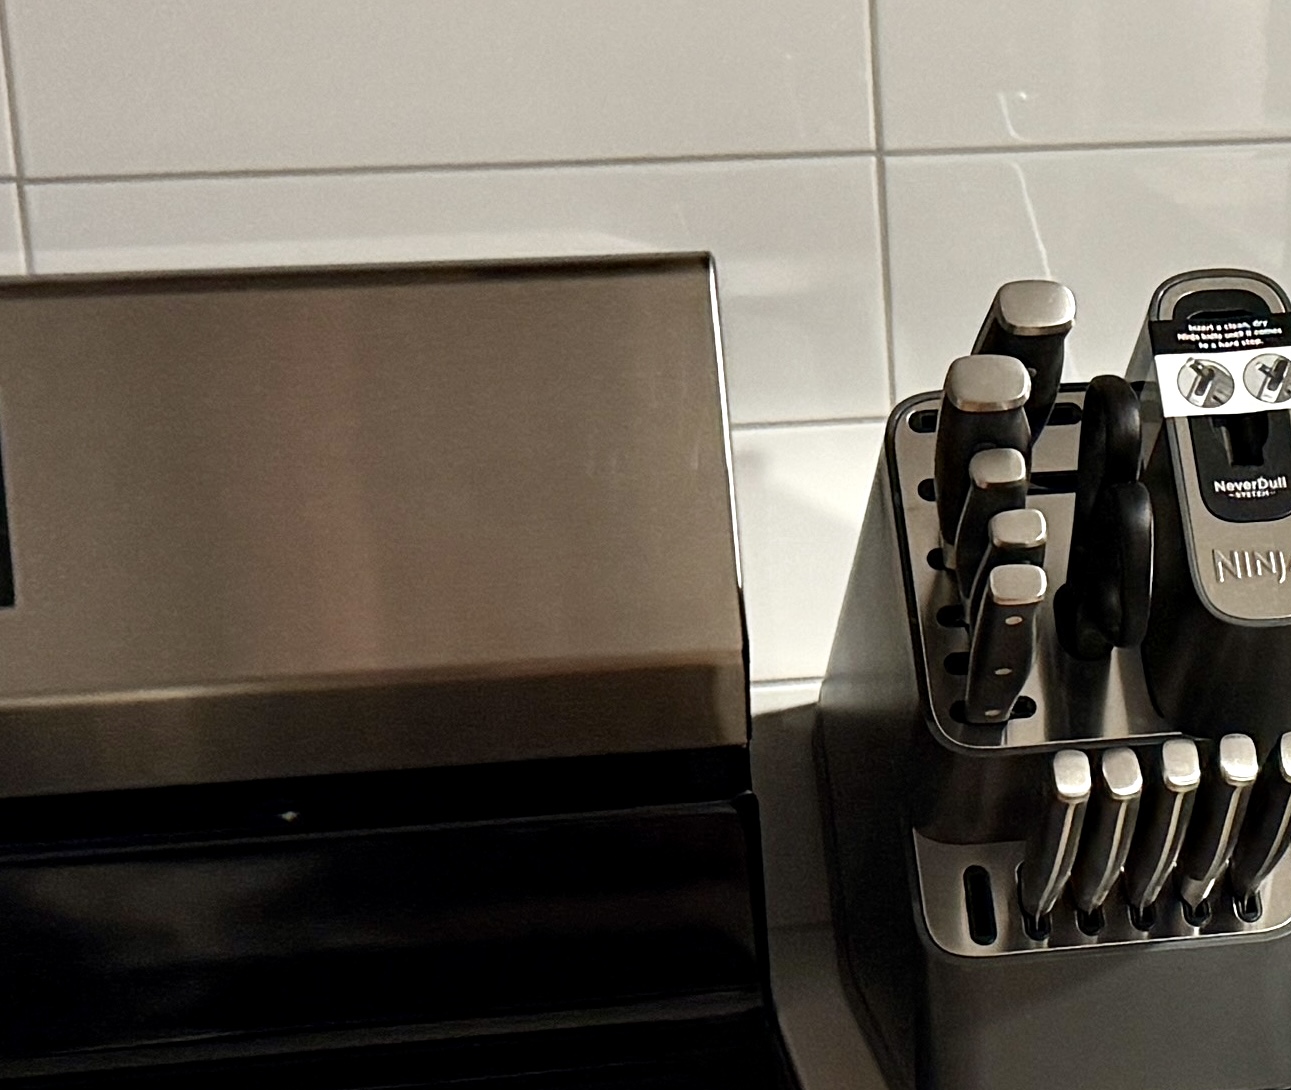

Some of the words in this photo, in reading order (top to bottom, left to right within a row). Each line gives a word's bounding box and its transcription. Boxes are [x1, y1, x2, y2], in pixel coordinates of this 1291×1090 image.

[1252, 319, 1269, 328] dry
[1218, 339, 1240, 348] hard
[1213, 475, 1288, 493] NeverDull
[1235, 490, 1270, 499] SYSTEM
